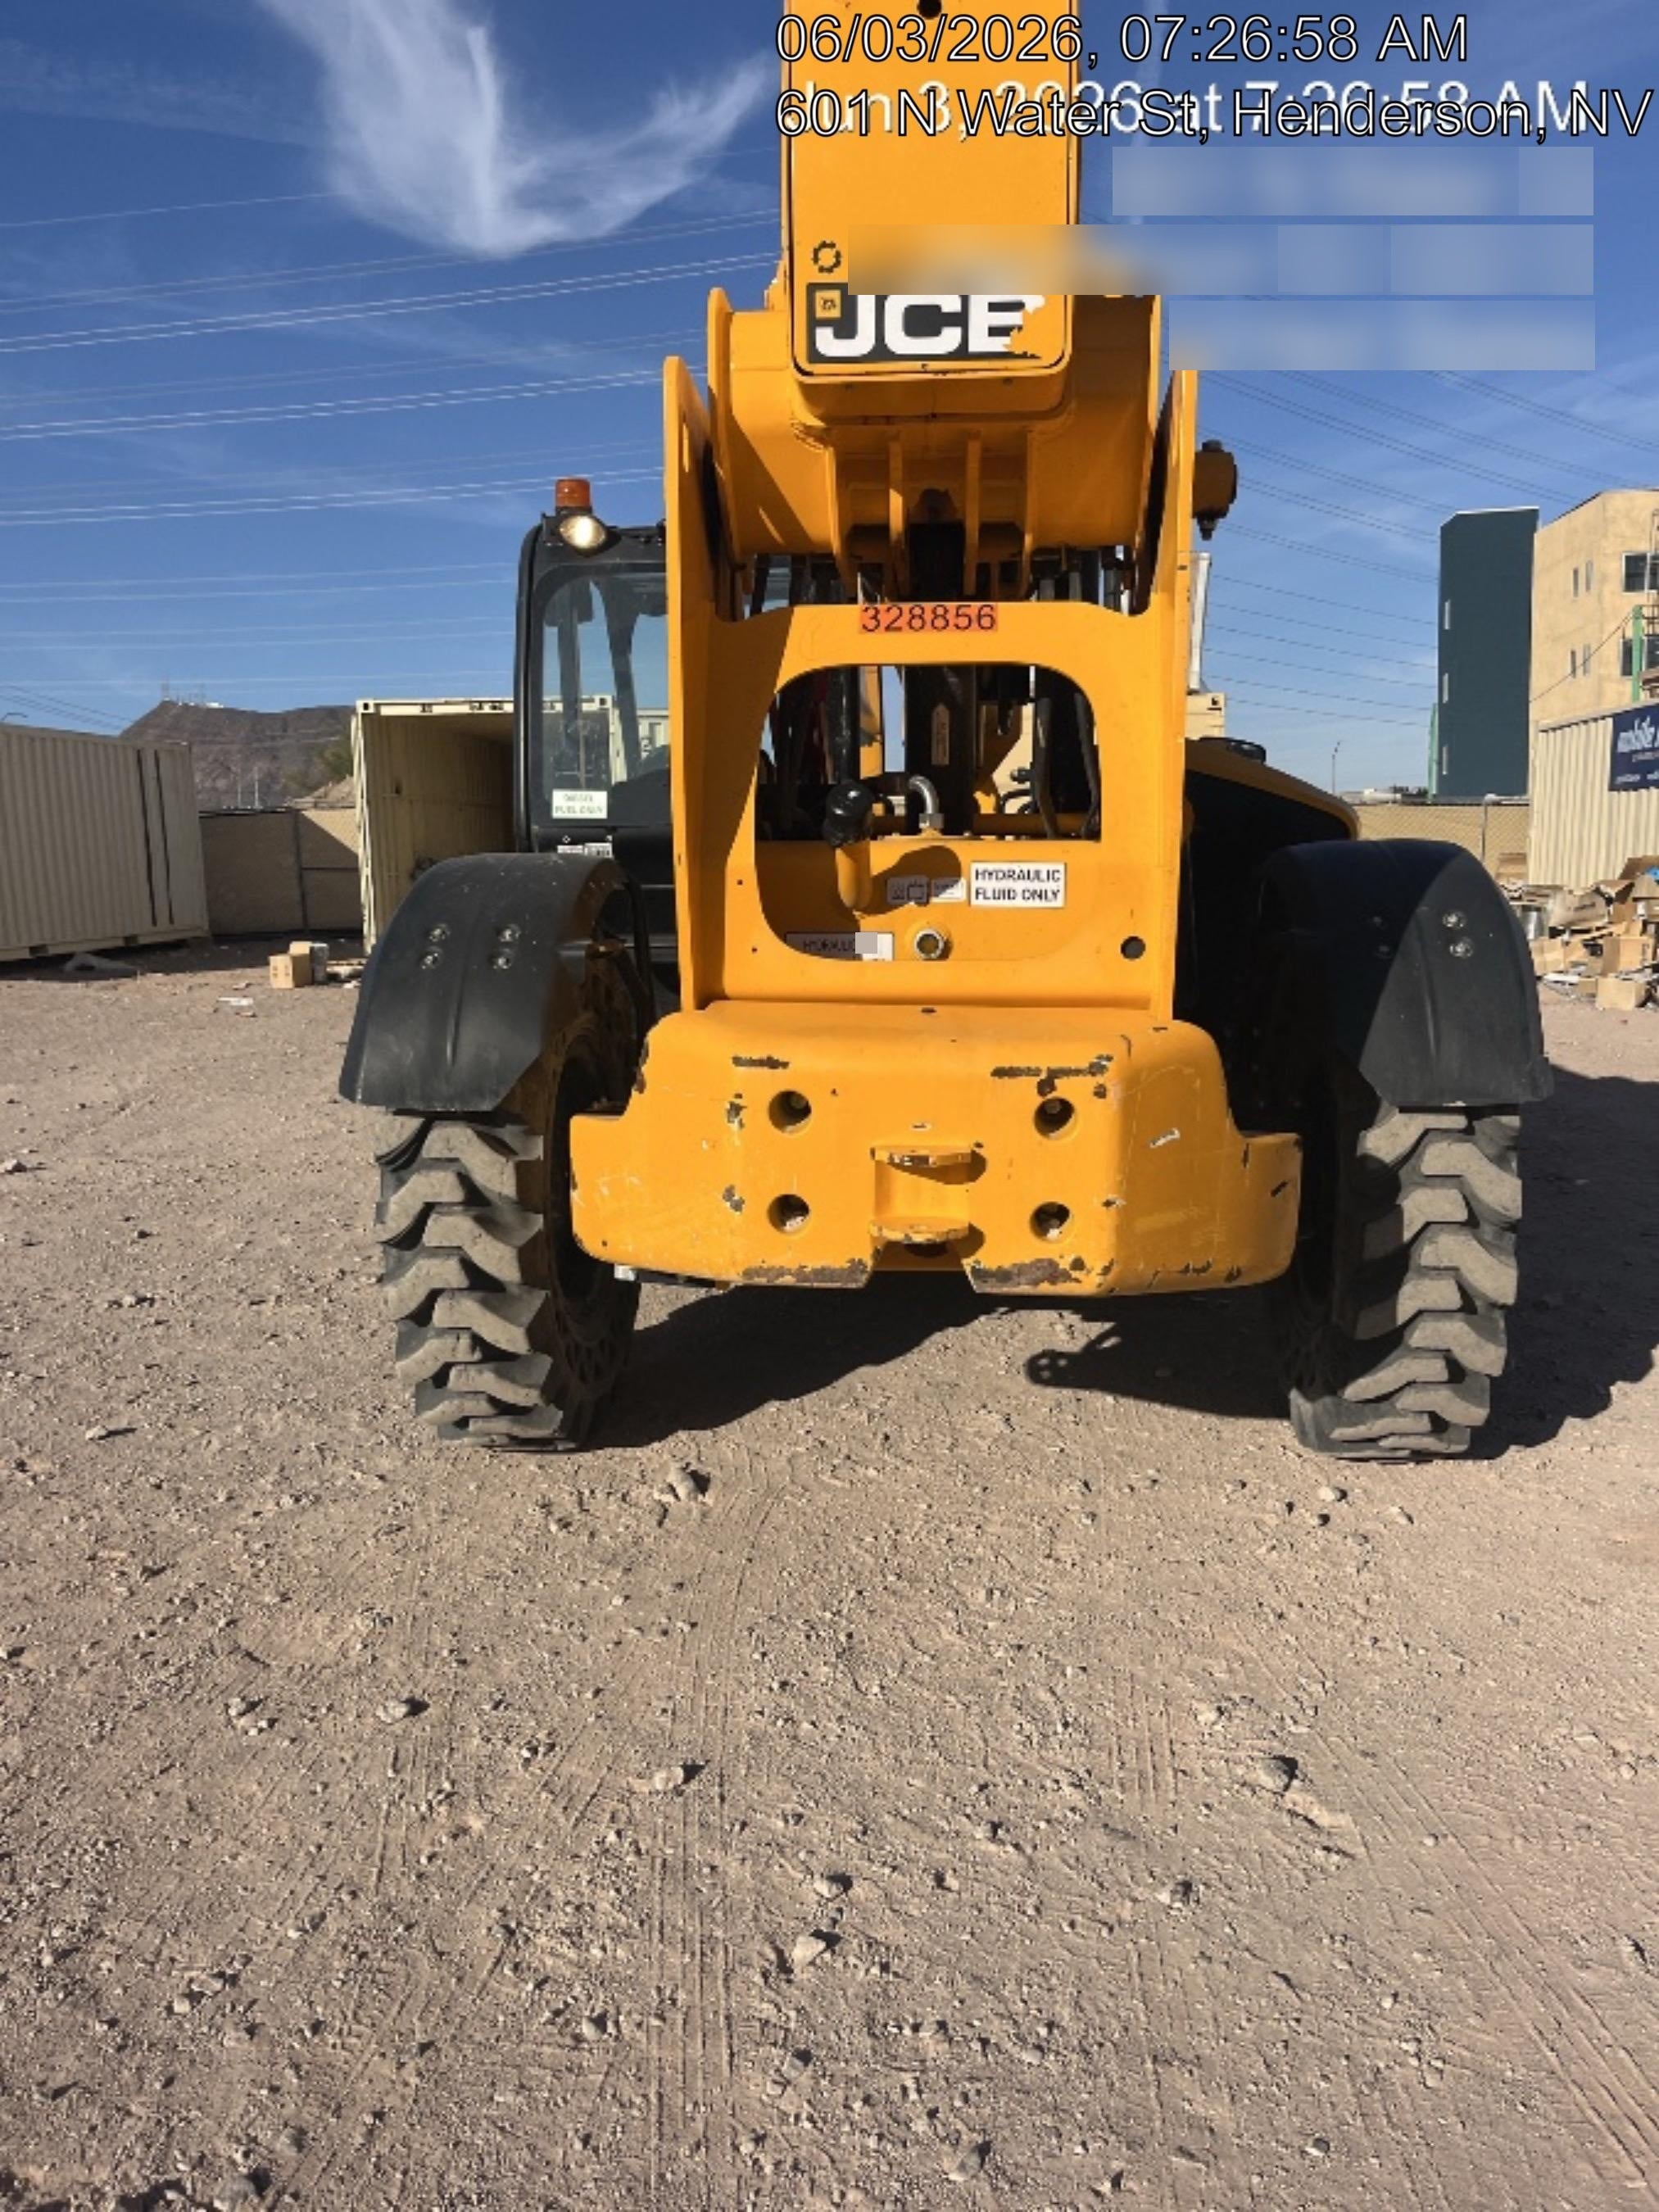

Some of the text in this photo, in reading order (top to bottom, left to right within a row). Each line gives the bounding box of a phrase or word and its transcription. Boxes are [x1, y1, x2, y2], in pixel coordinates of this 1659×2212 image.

[861, 604, 996, 632] 328856
[975, 868, 1061, 882] HYDRAULIC
[975, 887, 1018, 900] FLUID
[1022, 888, 1061, 902] ONLY
